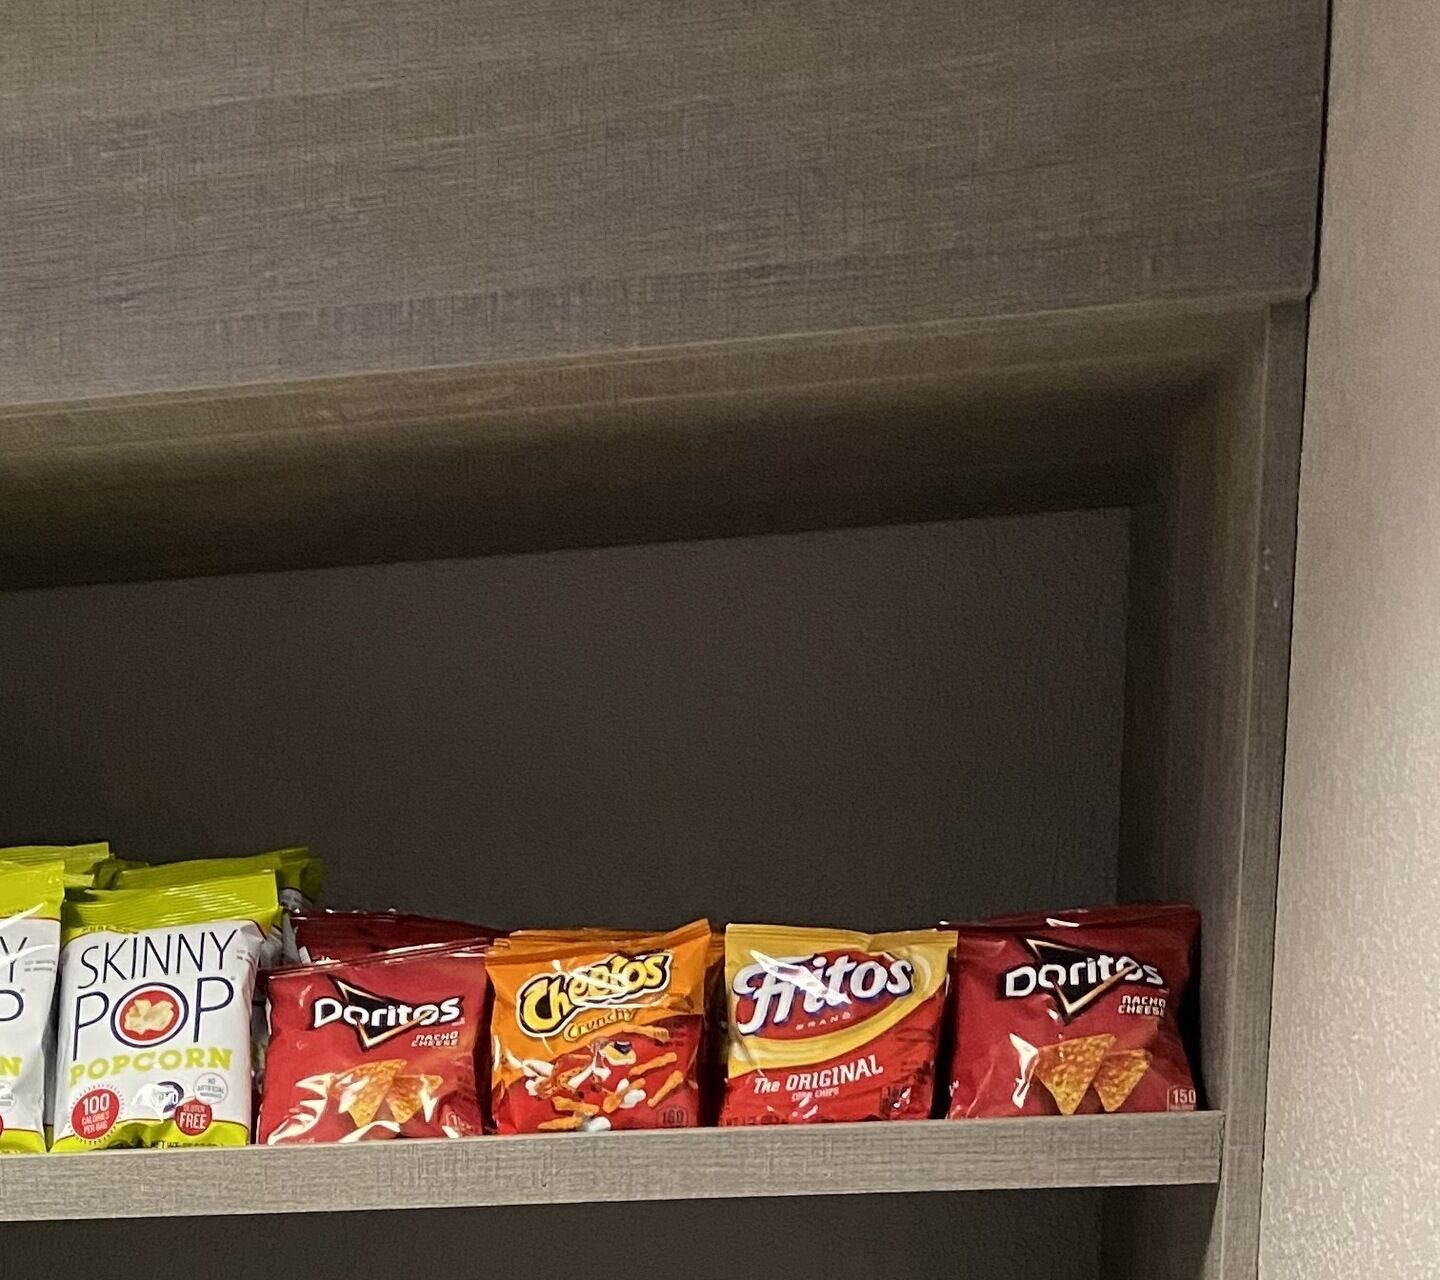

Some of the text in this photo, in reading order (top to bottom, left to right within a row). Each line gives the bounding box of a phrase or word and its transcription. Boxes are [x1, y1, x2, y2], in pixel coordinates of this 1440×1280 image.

[78, 929, 238, 990] SKINNY
[1005, 955, 1164, 998] Doritos
[732, 953, 911, 1035] Fritos
[1122, 995, 1166, 1009] NACHO
[73, 977, 235, 1061] POP
[314, 998, 462, 1029] Doritos
[565, 1007, 636, 1042] Crunchy
[796, 1011, 852, 1031] BRAND
[70, 1047, 233, 1087] POPCORN
[754, 1054, 884, 1095] The ORIGINAL
[82, 1093, 110, 1115] 100
[1172, 1089, 1197, 1104] 150
[179, 1113, 208, 1130] FREE
